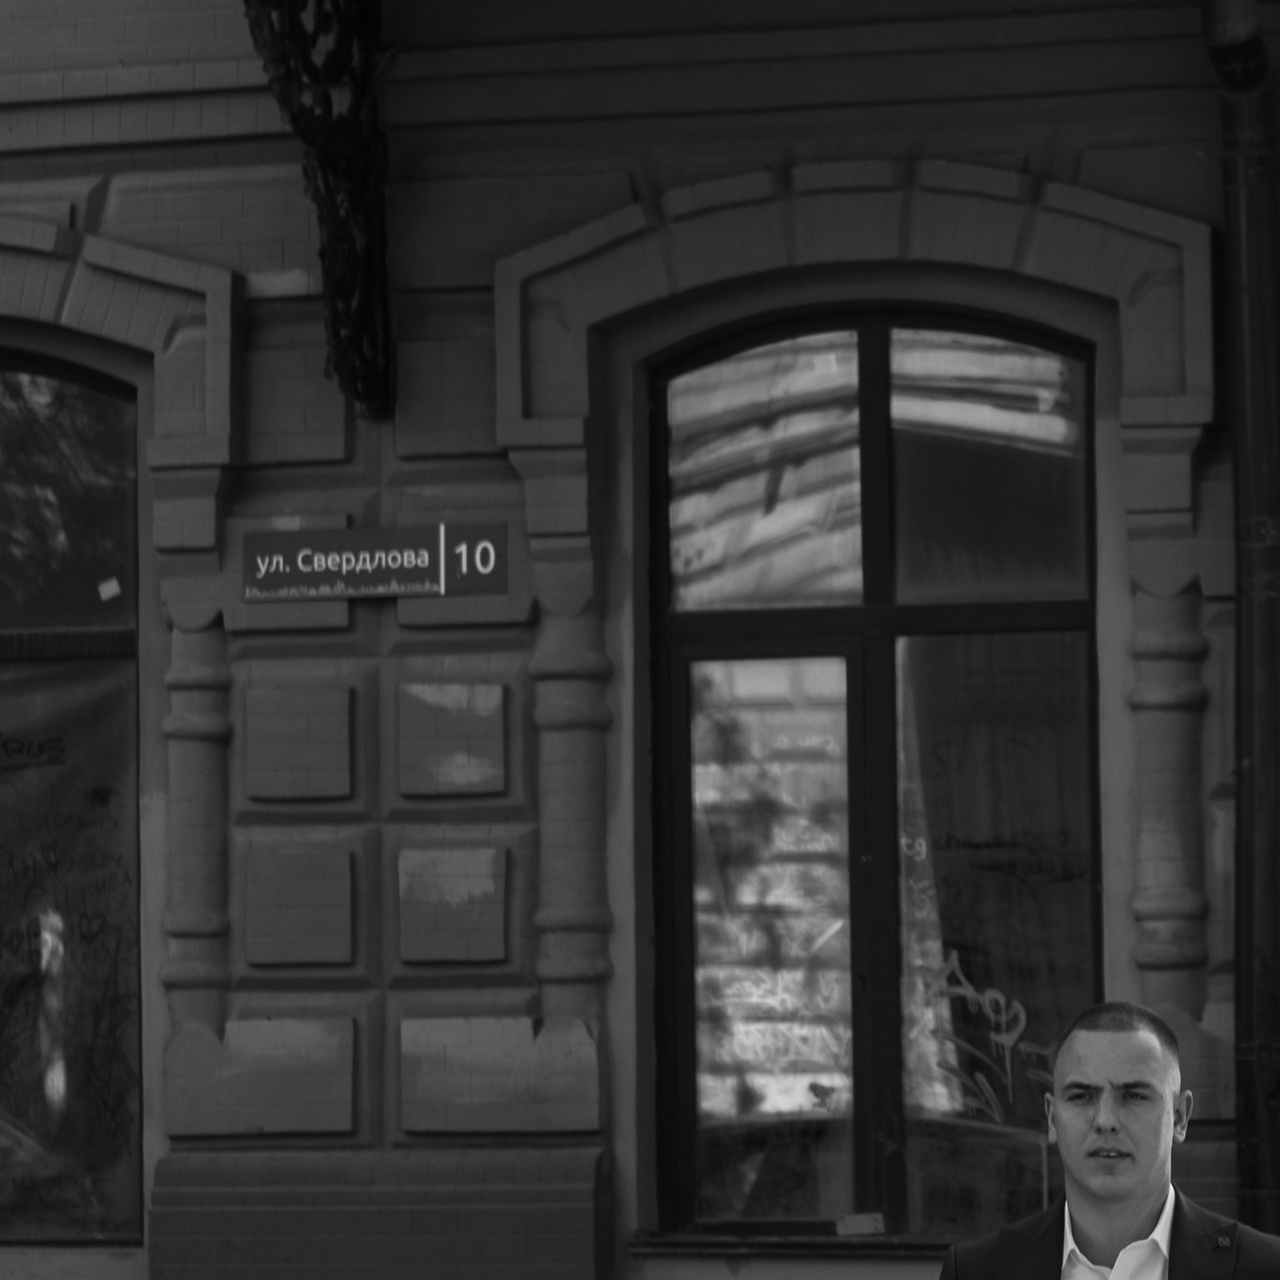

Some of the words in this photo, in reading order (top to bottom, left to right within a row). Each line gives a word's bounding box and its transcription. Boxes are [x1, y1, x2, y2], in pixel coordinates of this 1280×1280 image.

[256, 553, 291, 579] ул.
[297, 548, 430, 576] Свердлова
[454, 540, 497, 575] 10
